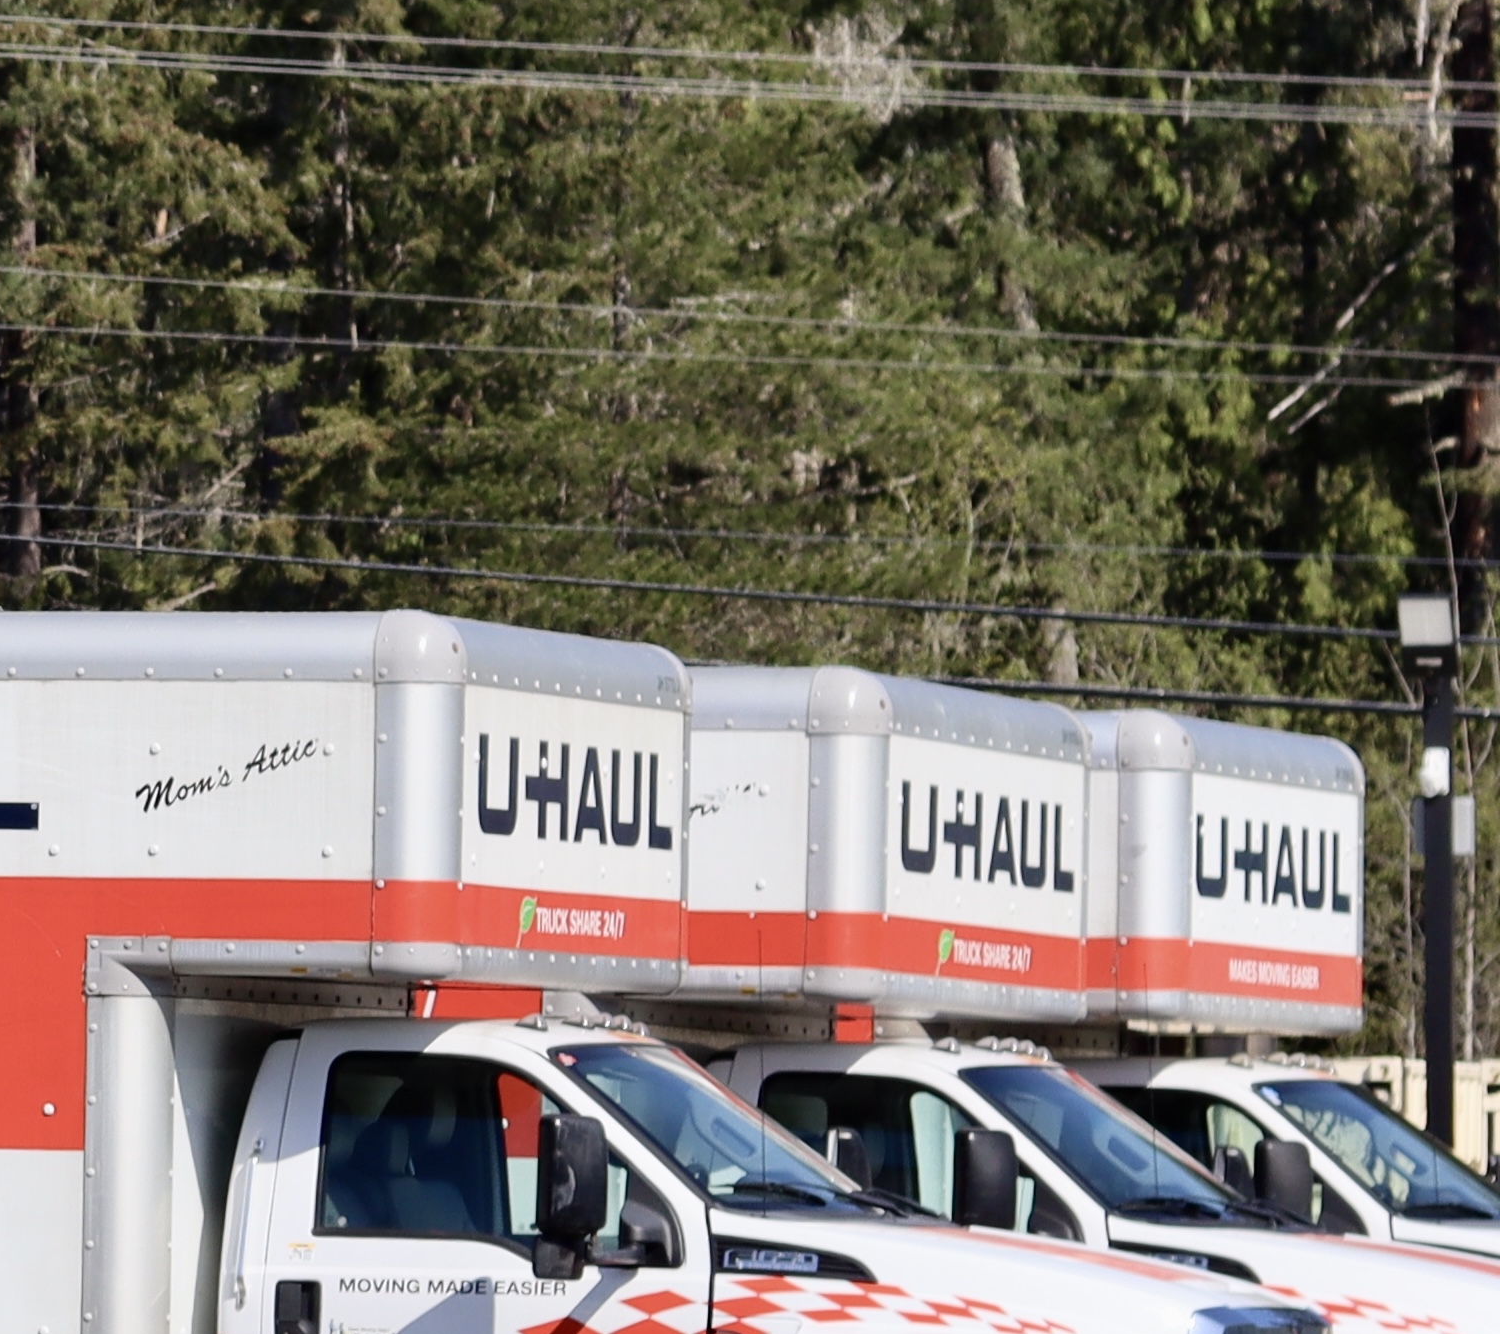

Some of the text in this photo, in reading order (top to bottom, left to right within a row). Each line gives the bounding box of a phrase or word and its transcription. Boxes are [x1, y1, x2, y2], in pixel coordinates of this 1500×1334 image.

[136, 738, 317, 813] Mom's Attic
[477, 733, 673, 850] U-HAUL
[900, 780, 1074, 893] U-HAUL
[1195, 813, 1352, 915] U-HAUL
[535, 908, 625, 939] TRUCK SHARE 24/7
[953, 939, 1032, 973] TRUCK SHARE 24/7
[1228, 958, 1320, 989] MAKES MOVING EASIER
[338, 1278, 567, 1296] MOVING MADE EASIER
